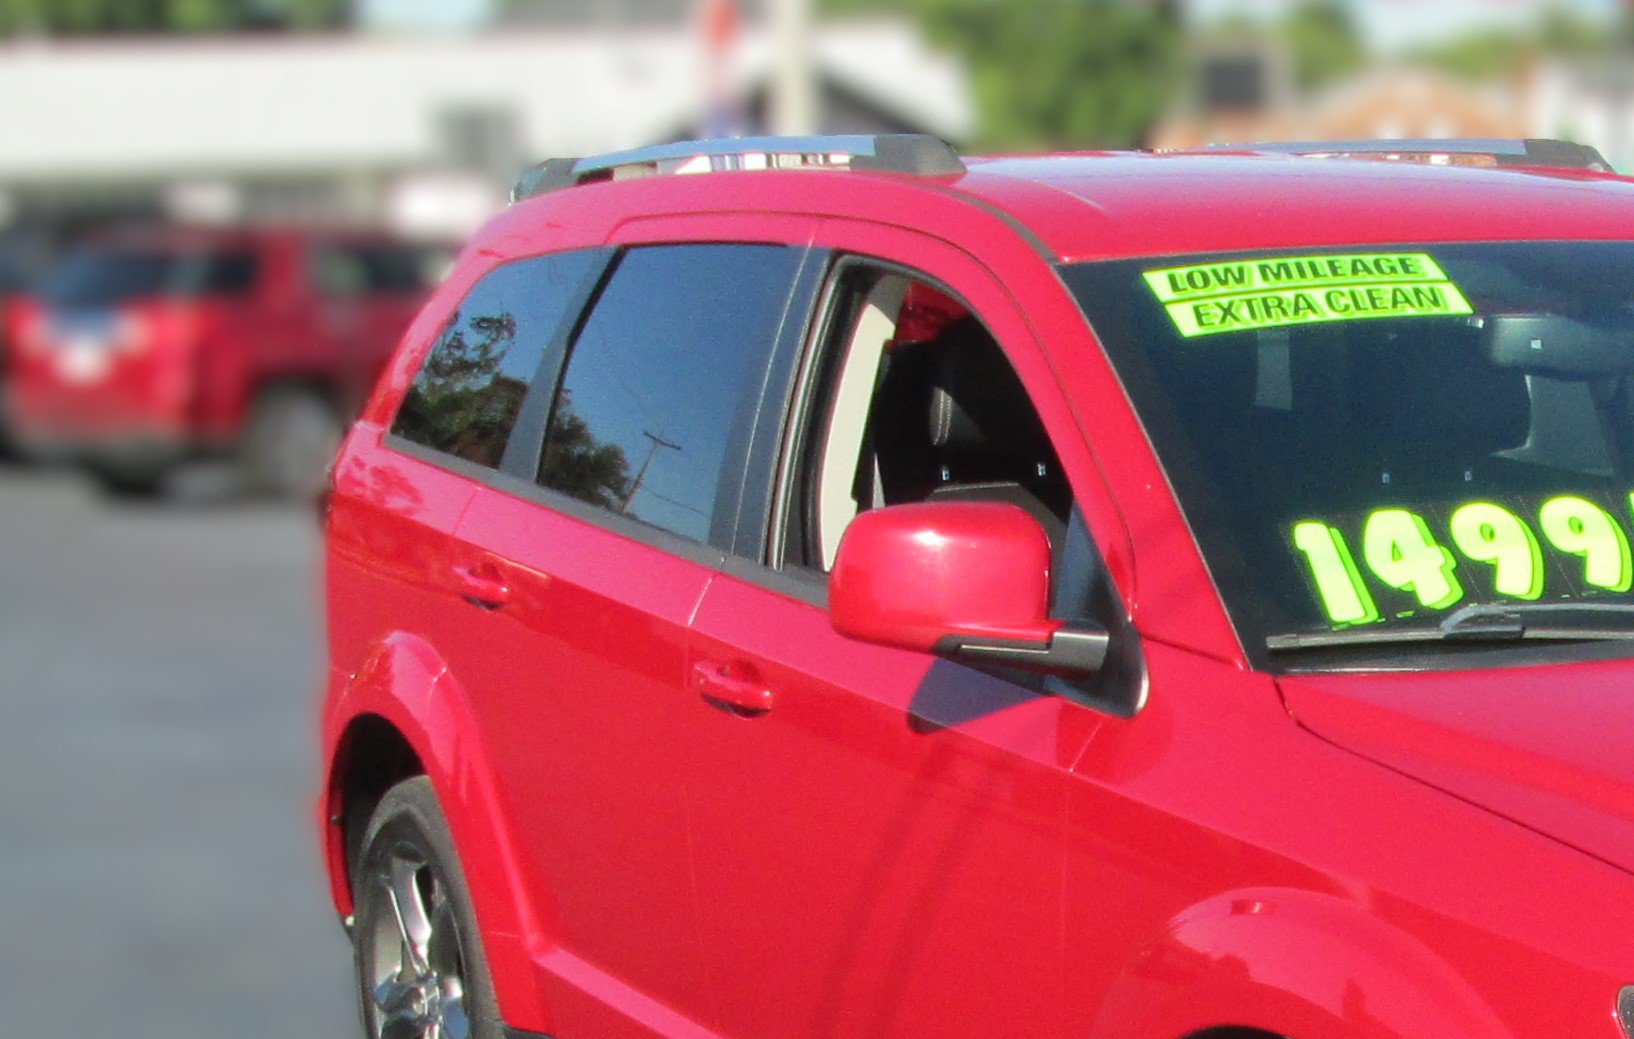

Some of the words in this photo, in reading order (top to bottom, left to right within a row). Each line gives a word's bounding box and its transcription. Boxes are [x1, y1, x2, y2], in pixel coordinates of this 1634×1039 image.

[1167, 263, 1246, 294] LOW
[1258, 254, 1423, 284] MILEAGE
[1193, 293, 1316, 328] EXTRA
[1324, 286, 1442, 315] CLEAN
